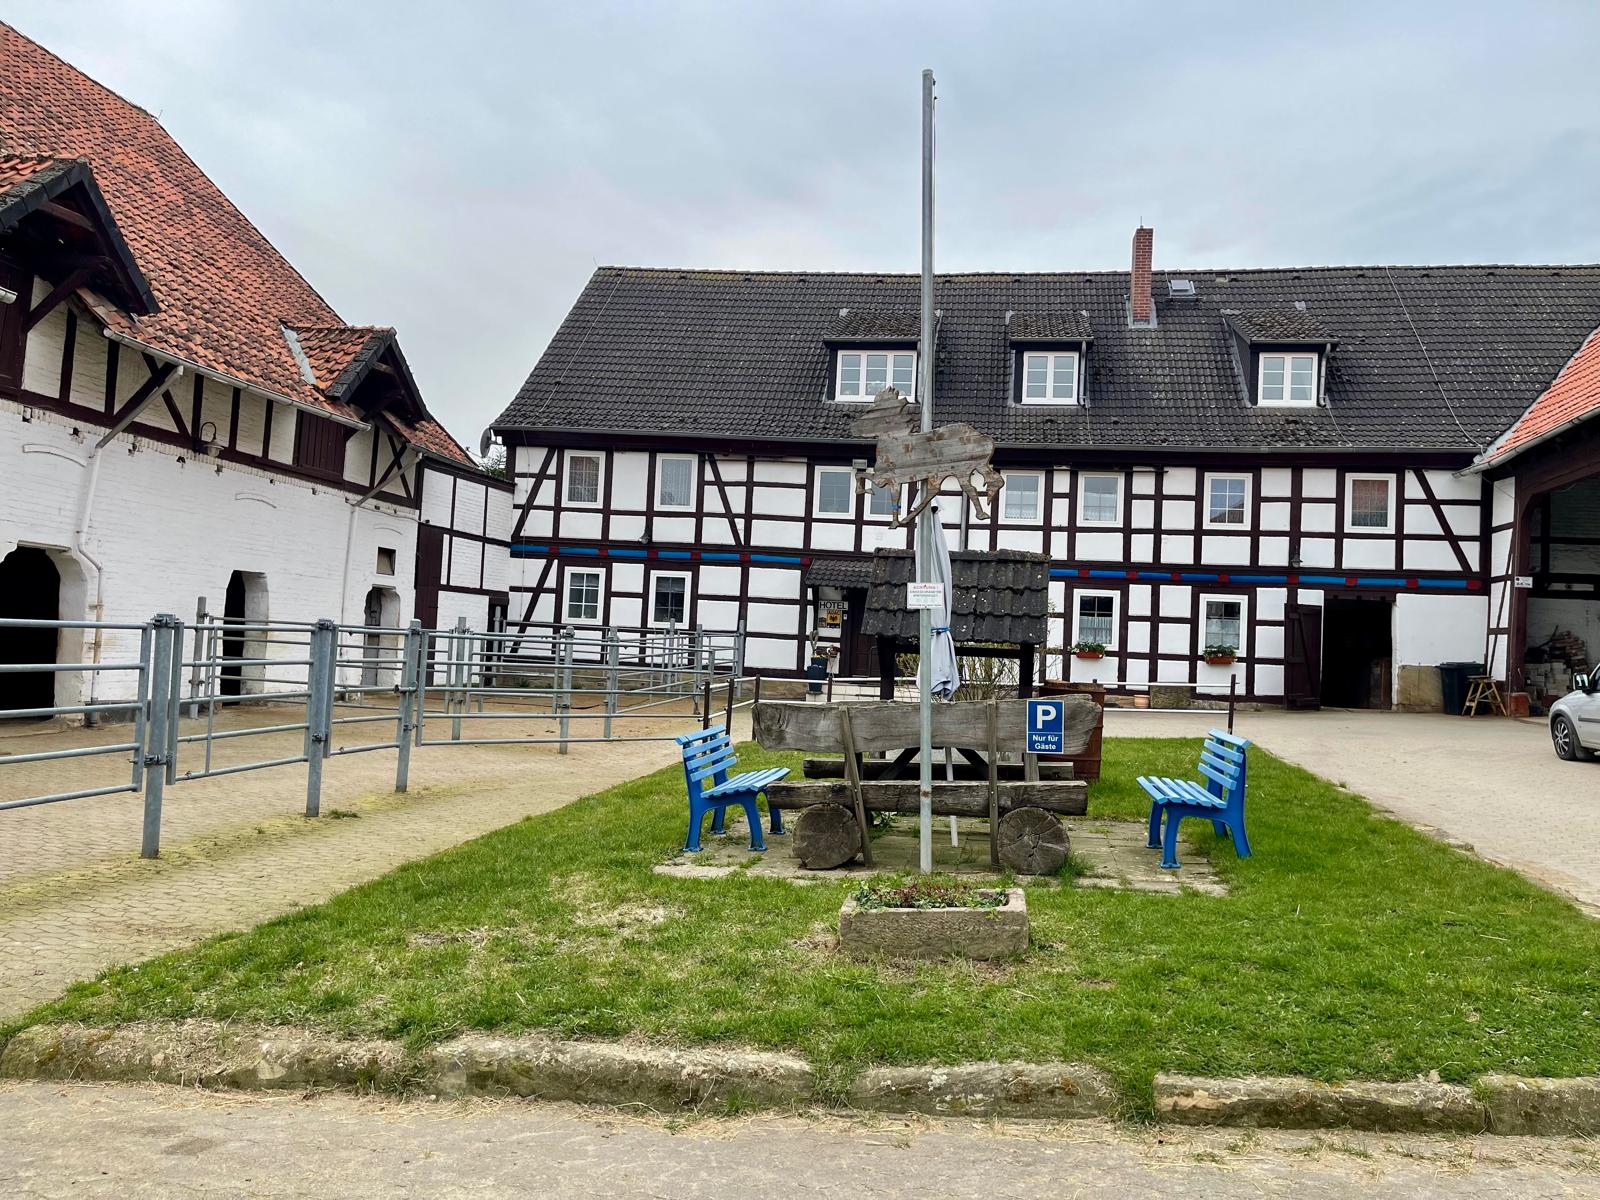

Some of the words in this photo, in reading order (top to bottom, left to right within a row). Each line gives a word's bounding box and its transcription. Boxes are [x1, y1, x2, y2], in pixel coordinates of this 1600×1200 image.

[819, 601, 847, 609] HOTEL
[1036, 704, 1057, 729] P
[1032, 734, 1047, 742] Nur
[1047, 734, 1059, 742] für
